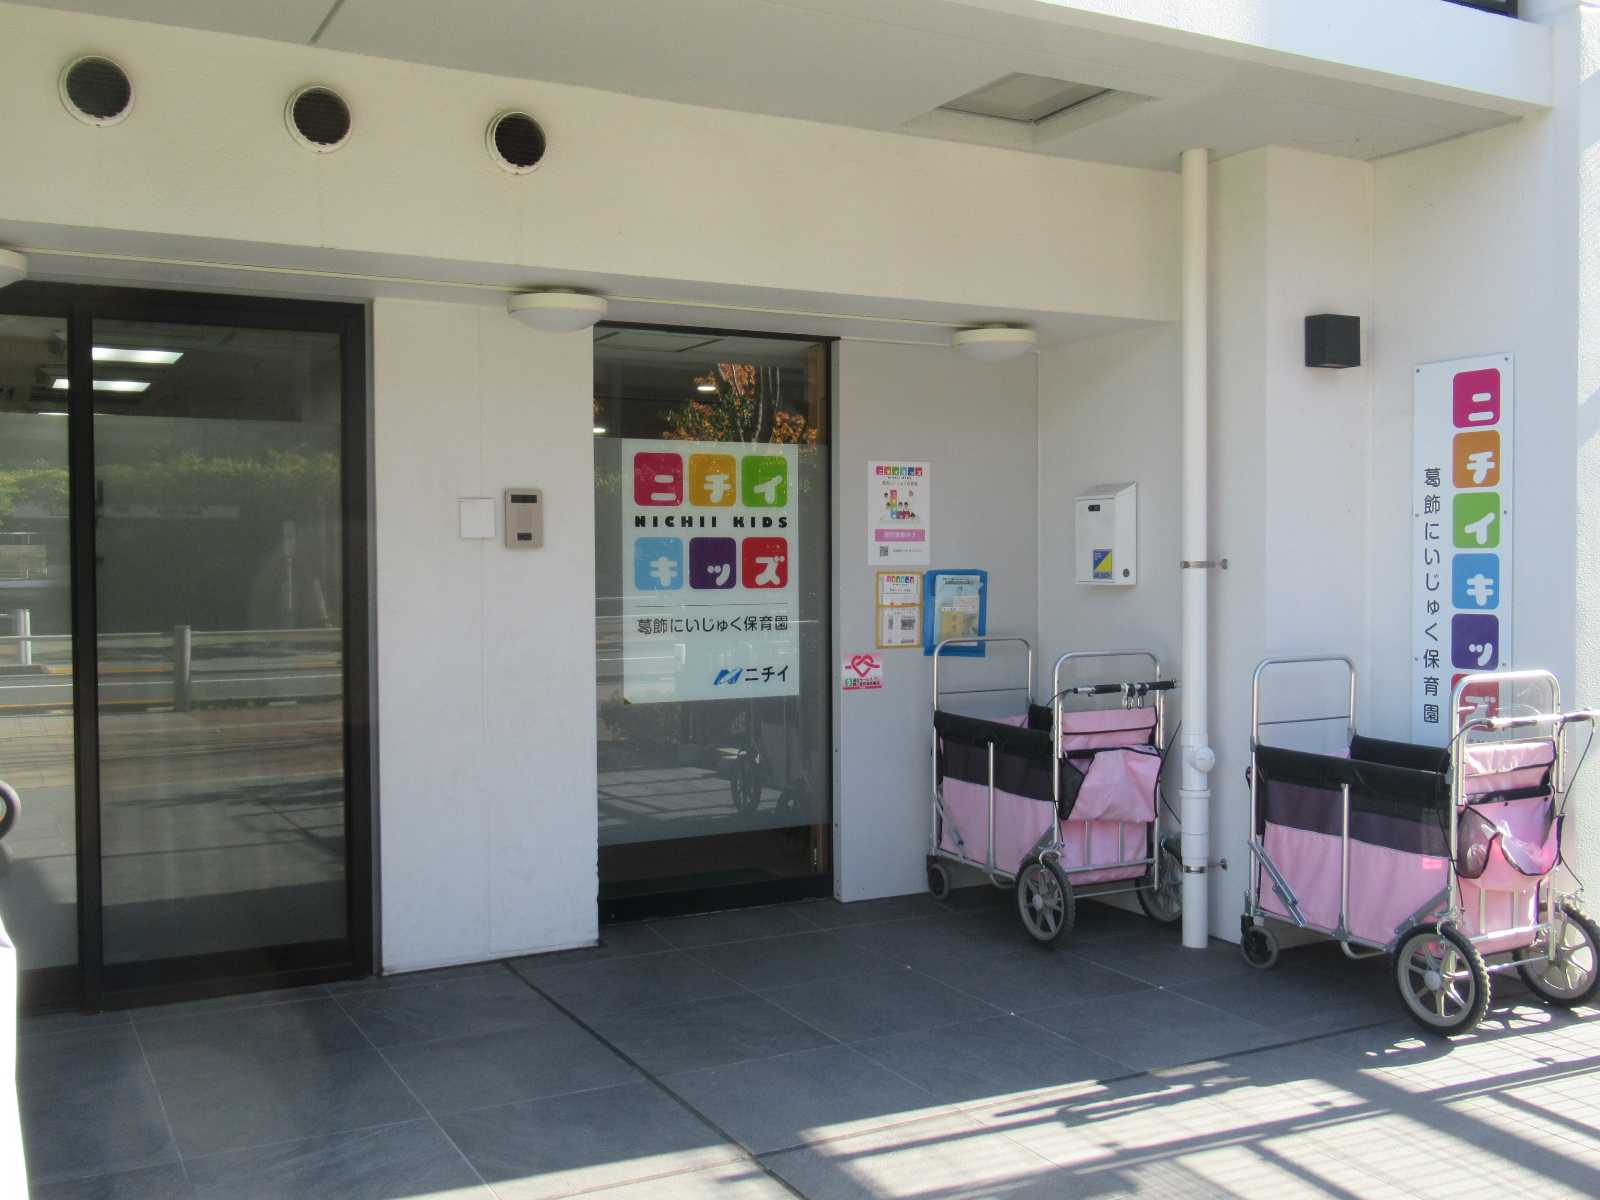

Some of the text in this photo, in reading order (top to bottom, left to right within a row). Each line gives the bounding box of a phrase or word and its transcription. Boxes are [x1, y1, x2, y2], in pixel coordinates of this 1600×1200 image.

[647, 471, 785, 506] ニチイ
[634, 515, 788, 528] NICHII KIDS
[647, 553, 786, 588] キッズ
[1422, 467, 1441, 724] 葛飾にいじゅく保育園
[636, 615, 789, 635] 葛飾にいじゅく保育園
[744, 665, 789, 683] ニチイ
